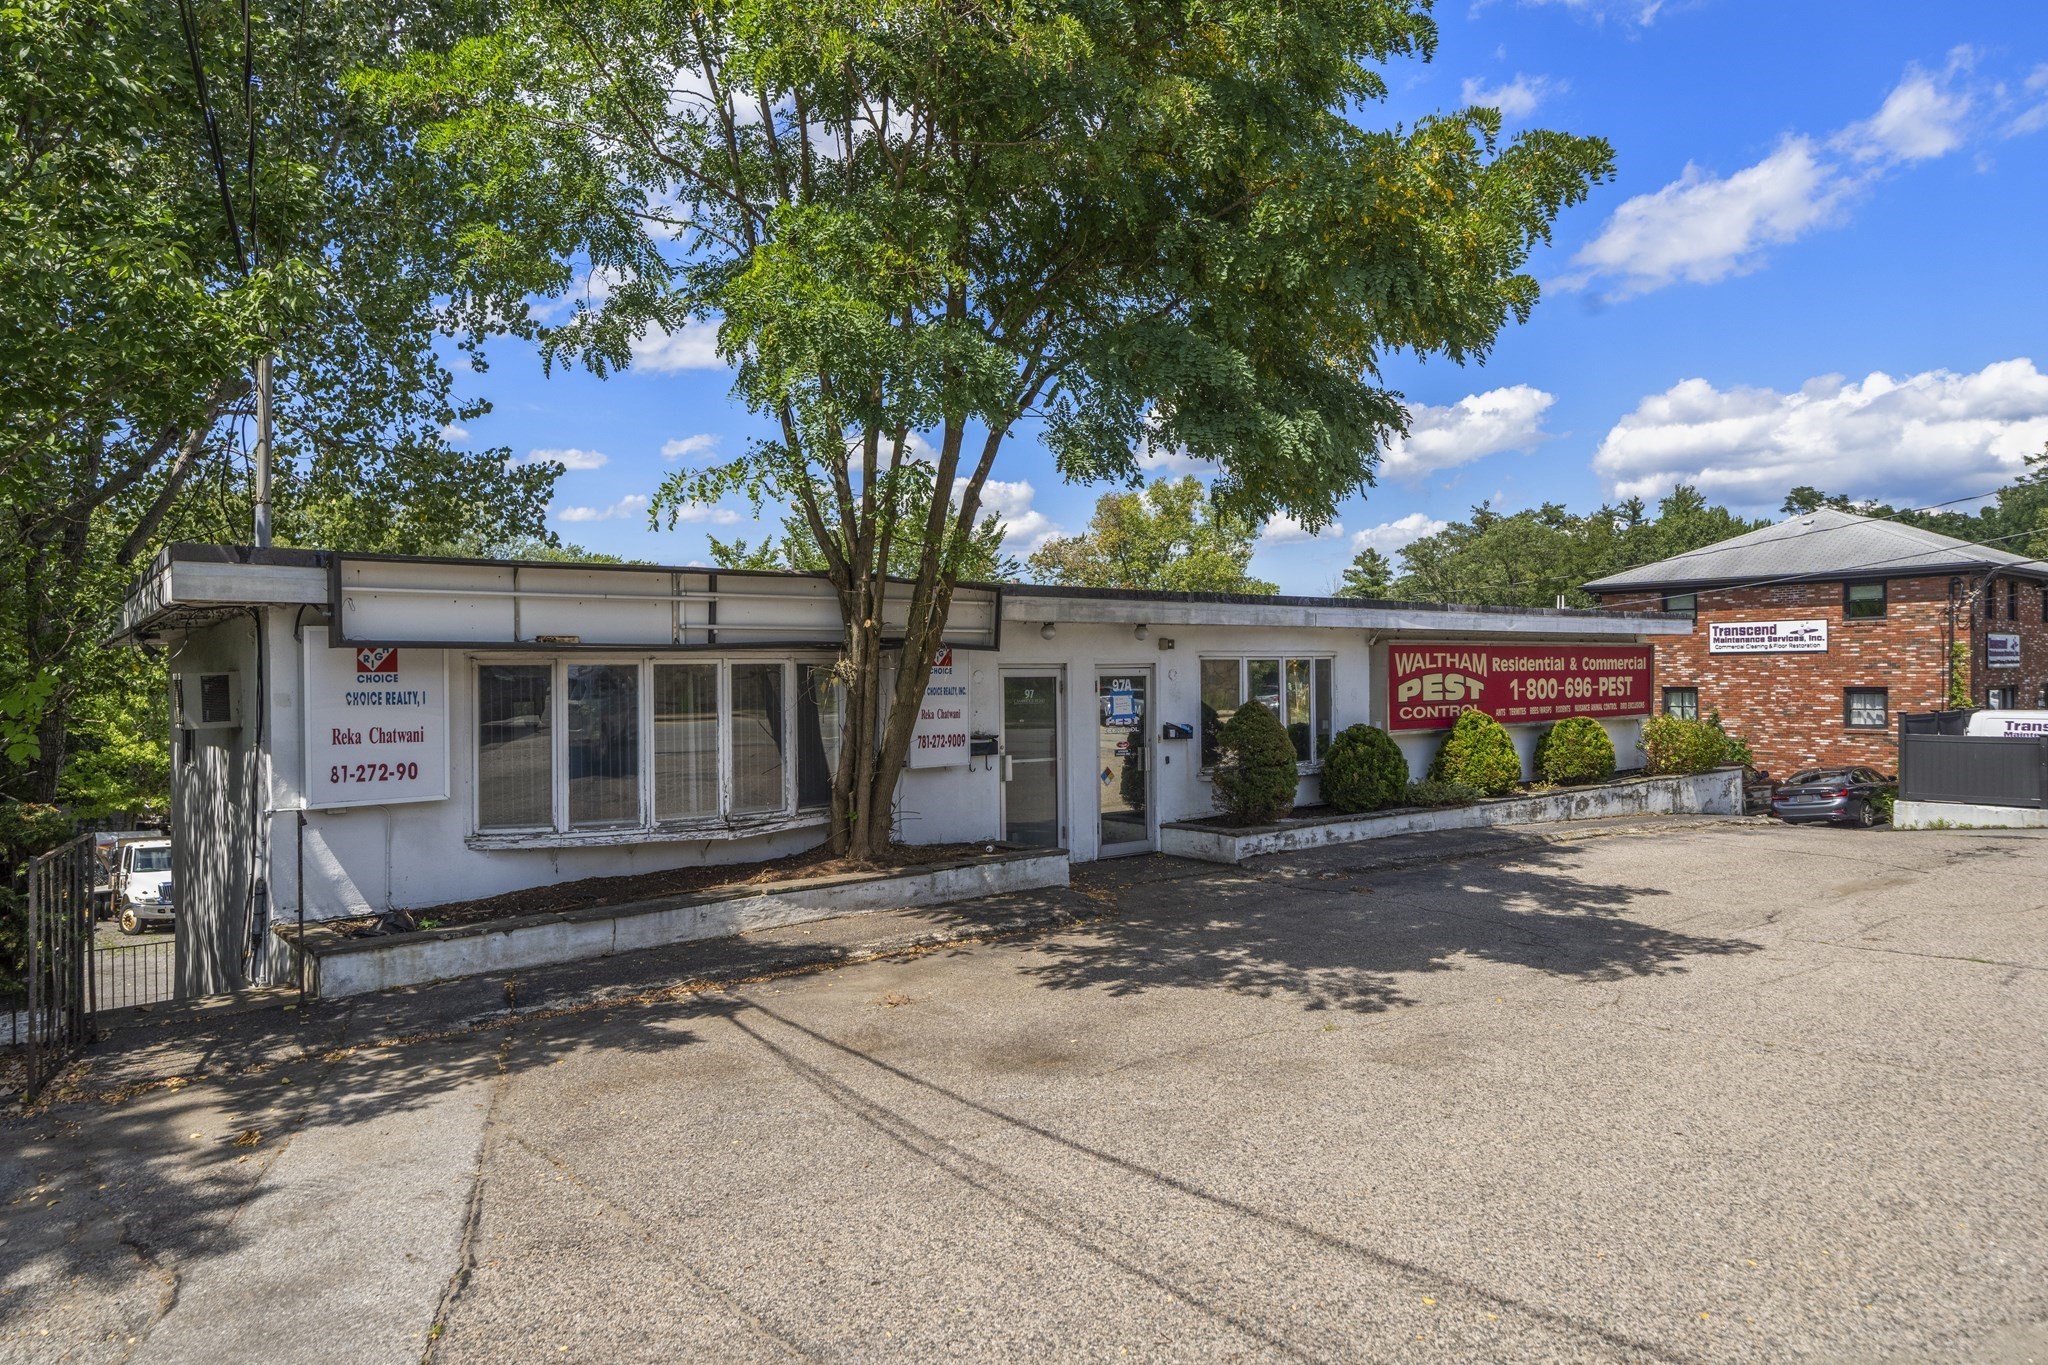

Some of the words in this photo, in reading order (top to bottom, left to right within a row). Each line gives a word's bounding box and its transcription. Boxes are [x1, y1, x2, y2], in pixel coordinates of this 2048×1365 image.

[1712, 624, 1777, 636] Transcend
[1808, 634, 1825, 642] Inc.
[1395, 653, 1487, 677] WALTHAM
[1492, 656, 1565, 672] Residential
[1570, 657, 1577, 671] &
[1582, 656, 1647, 671] Commercial
[357, 674, 398, 683] CHOICE
[1112, 679, 1132, 691] 97A
[927, 687, 943, 696] CHOICE
[1024, 689, 1034, 699] 97
[1398, 673, 1484, 702] PEST
[1509, 676, 1633, 700] 1-800-696-PEST
[346, 692, 382, 706] CHOICE
[386, 691, 420, 707] REALTY,
[921, 709, 934, 720] Reka
[937, 709, 961, 720] Chatwani
[332, 728, 361, 745] Reka
[369, 726, 424, 744] Chatwani
[918, 734, 966, 749] 781-272-9009
[330, 762, 418, 783] 81-272-90
